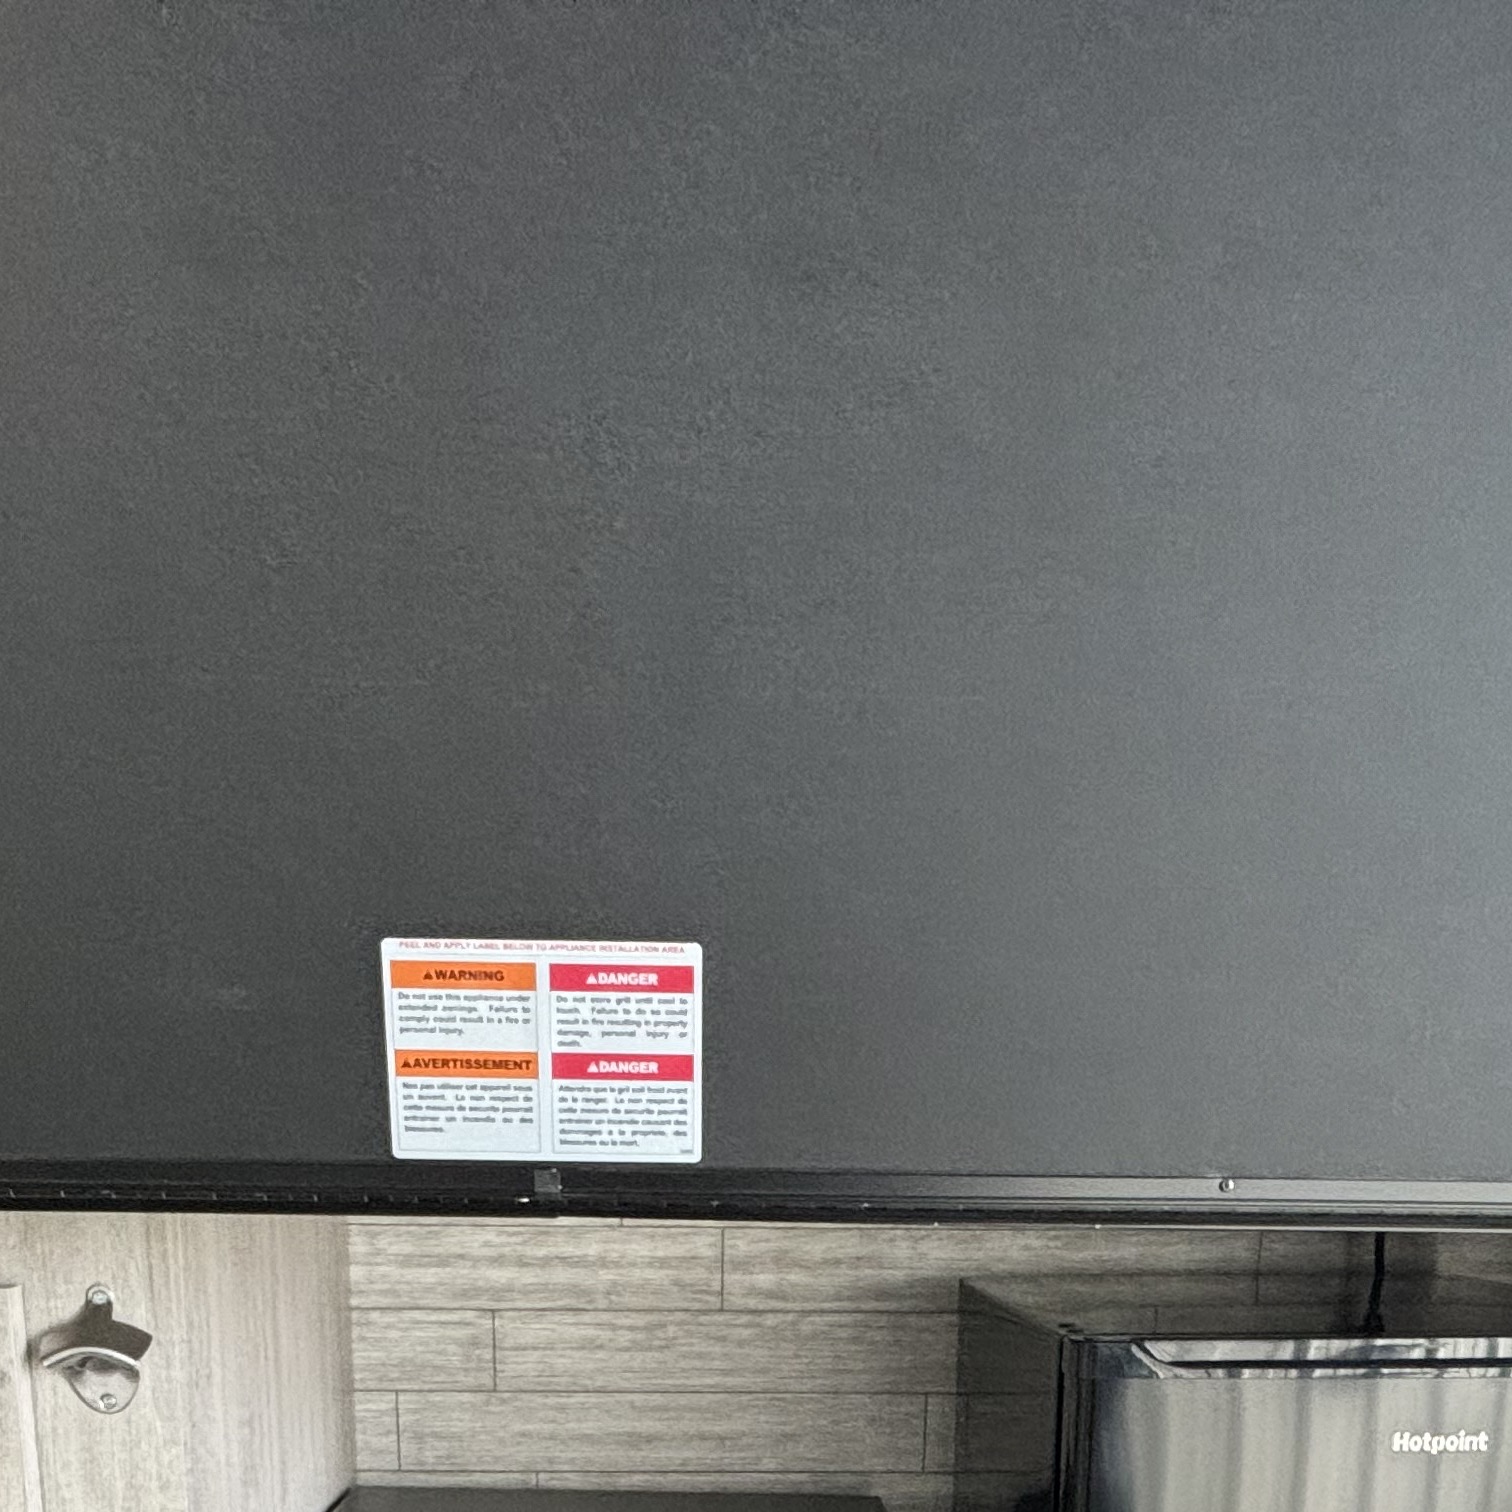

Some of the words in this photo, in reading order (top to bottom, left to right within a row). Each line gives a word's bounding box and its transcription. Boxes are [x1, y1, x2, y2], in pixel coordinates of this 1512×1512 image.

[444, 942, 470, 950] APPLY
[434, 969, 505, 982] WARNING
[598, 972, 659, 986] DANGER
[413, 1057, 533, 1071] AVERTISSEMENT
[599, 1061, 659, 1074] DANGER
[1391, 1429, 1489, 1455] Hotpoint
